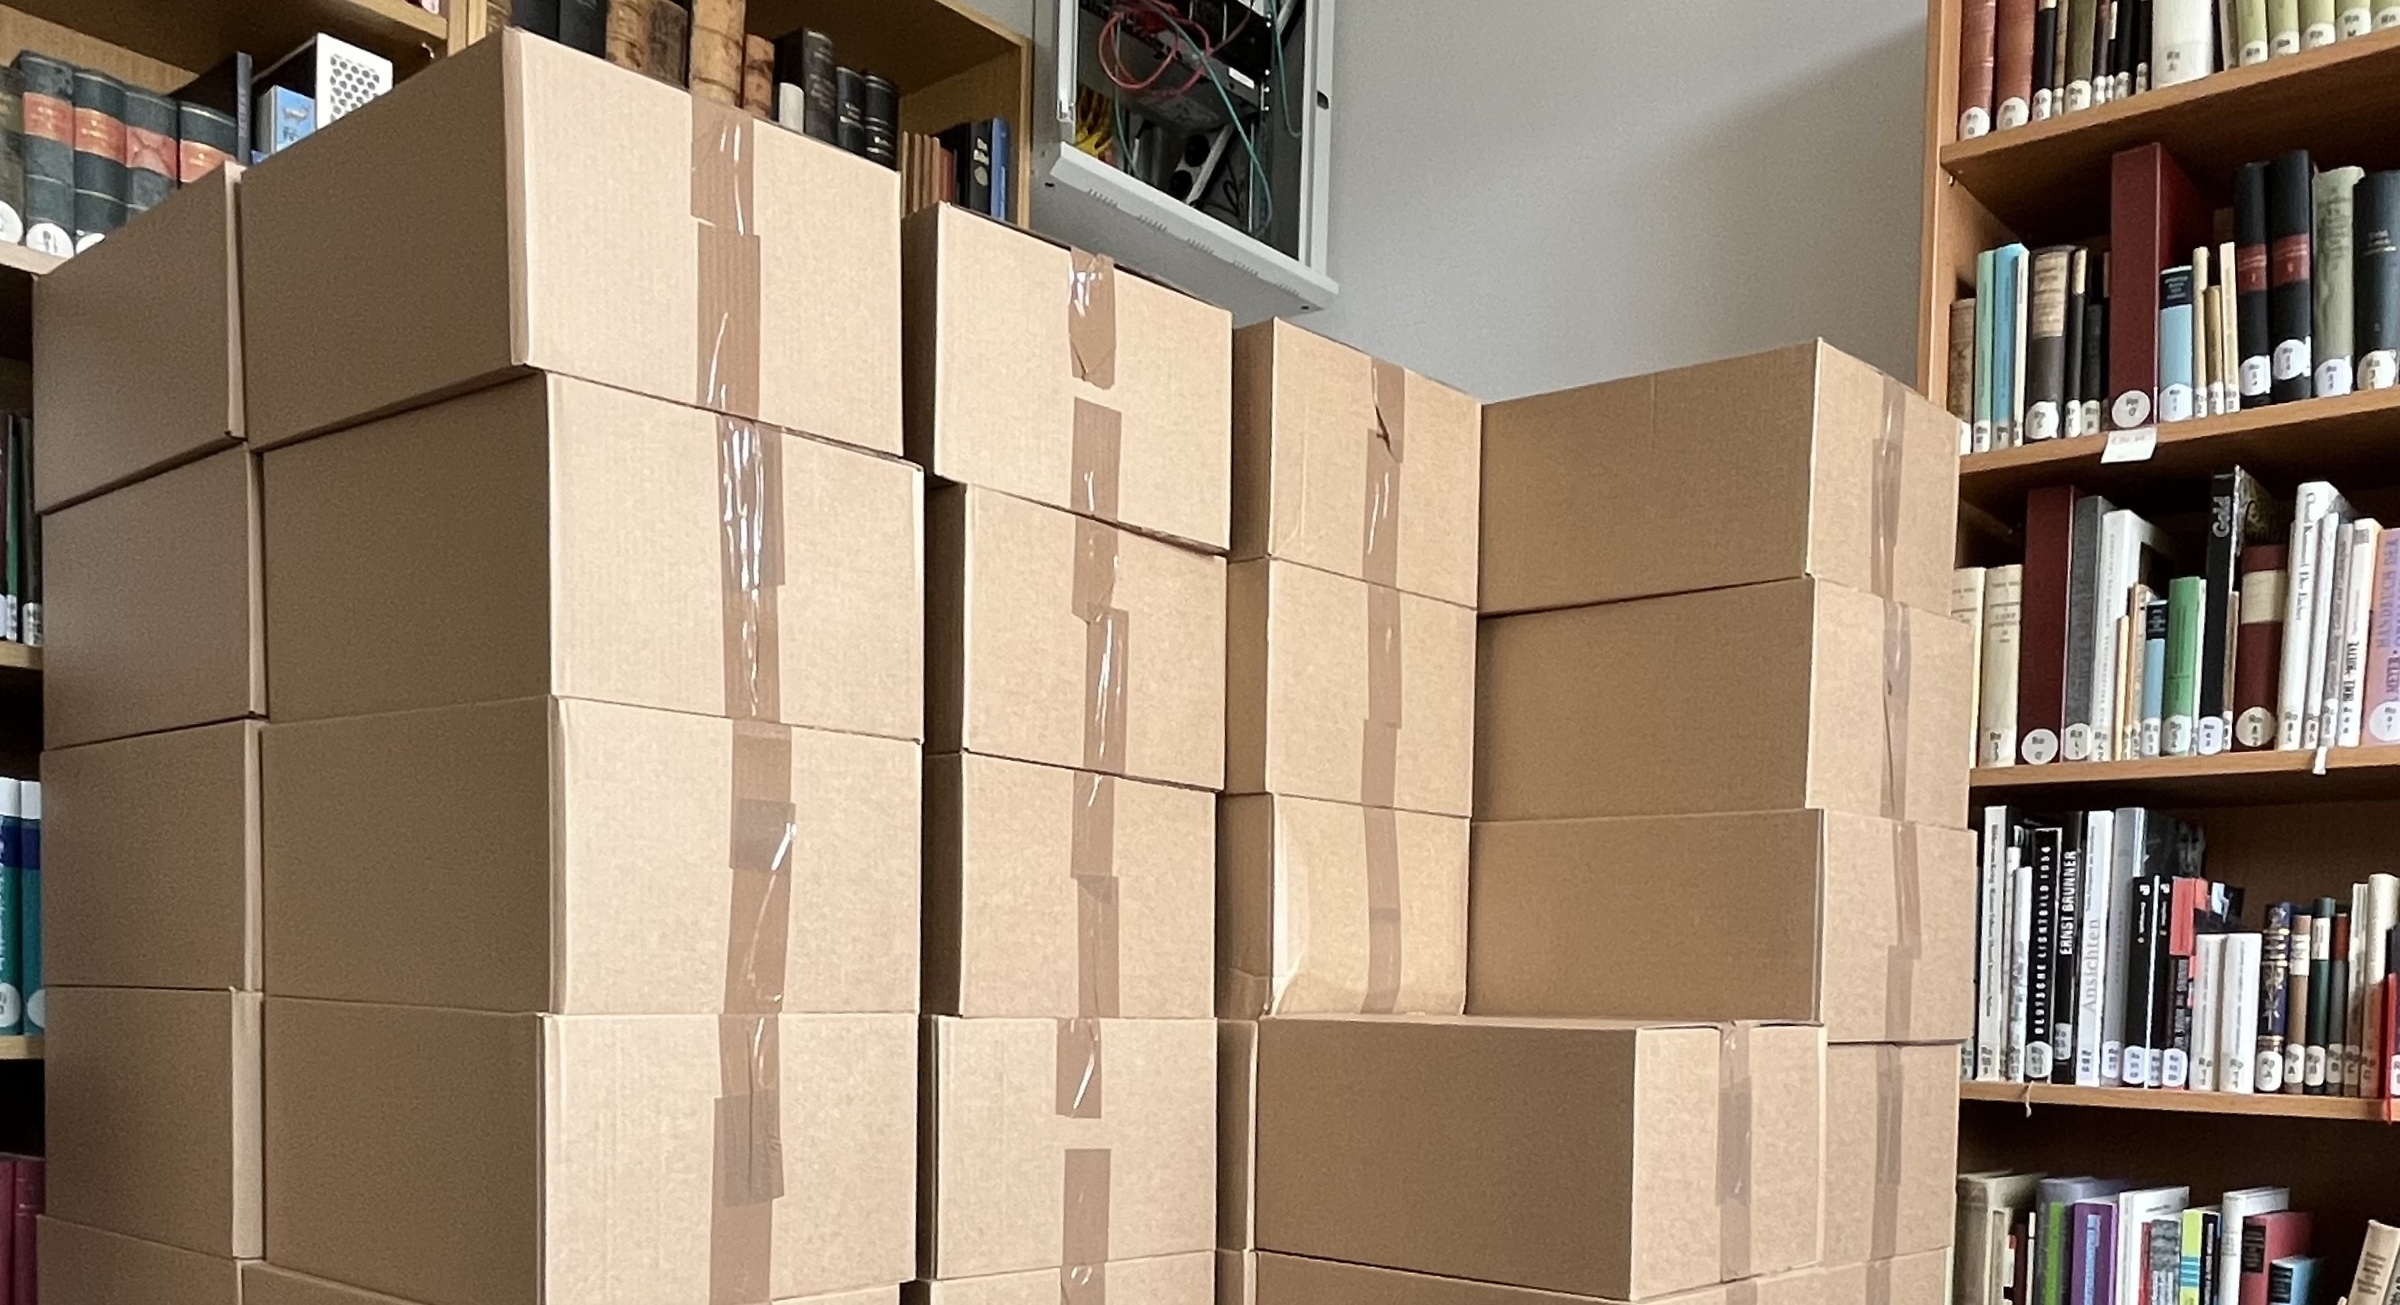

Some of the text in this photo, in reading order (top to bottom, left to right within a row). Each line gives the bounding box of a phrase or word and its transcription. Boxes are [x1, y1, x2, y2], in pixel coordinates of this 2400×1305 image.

[2060, 850, 2077, 956] ERNST BRUNNER
[2034, 963, 2047, 1035] DEUTSCHE
[2083, 918, 2100, 1012] Ansichten
